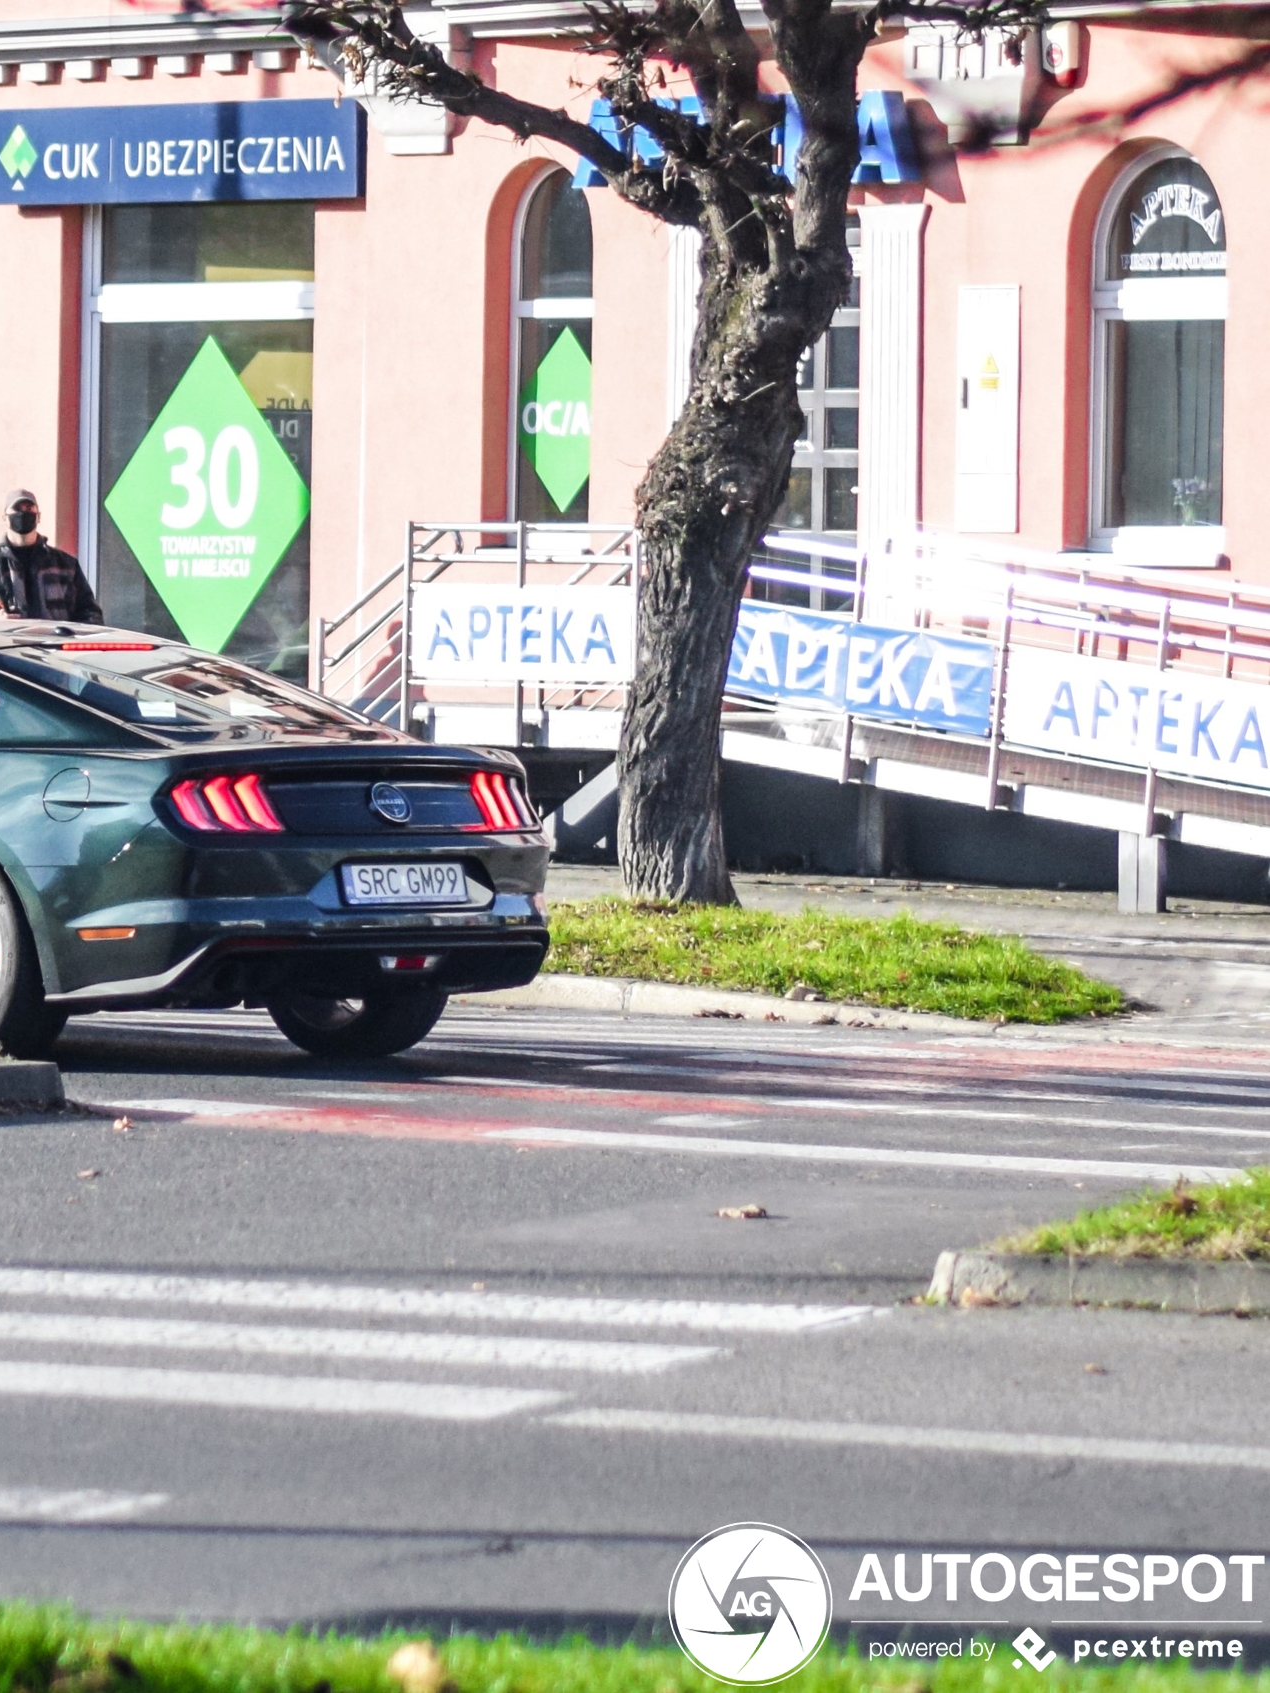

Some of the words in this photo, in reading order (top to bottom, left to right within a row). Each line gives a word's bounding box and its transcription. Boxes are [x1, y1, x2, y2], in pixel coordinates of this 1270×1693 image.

[43, 142, 100, 180] CUK
[124, 135, 347, 179] UBEZPIECZENIA
[1130, 184, 1221, 246] APTEKA
[160, 425, 259, 530] 30
[159, 535, 257, 555] TOWARZYSTW
[164, 559, 179, 577] W
[182, 559, 189, 577] 1
[192, 558, 250, 577] MIEJSCU
[426, 604, 617, 665] APTEKA
[738, 626, 959, 717] APTEKA
[1042, 679, 1269, 769] APTEKA
[357, 867, 400, 896] SRC
[406, 866, 458, 895] GM99
